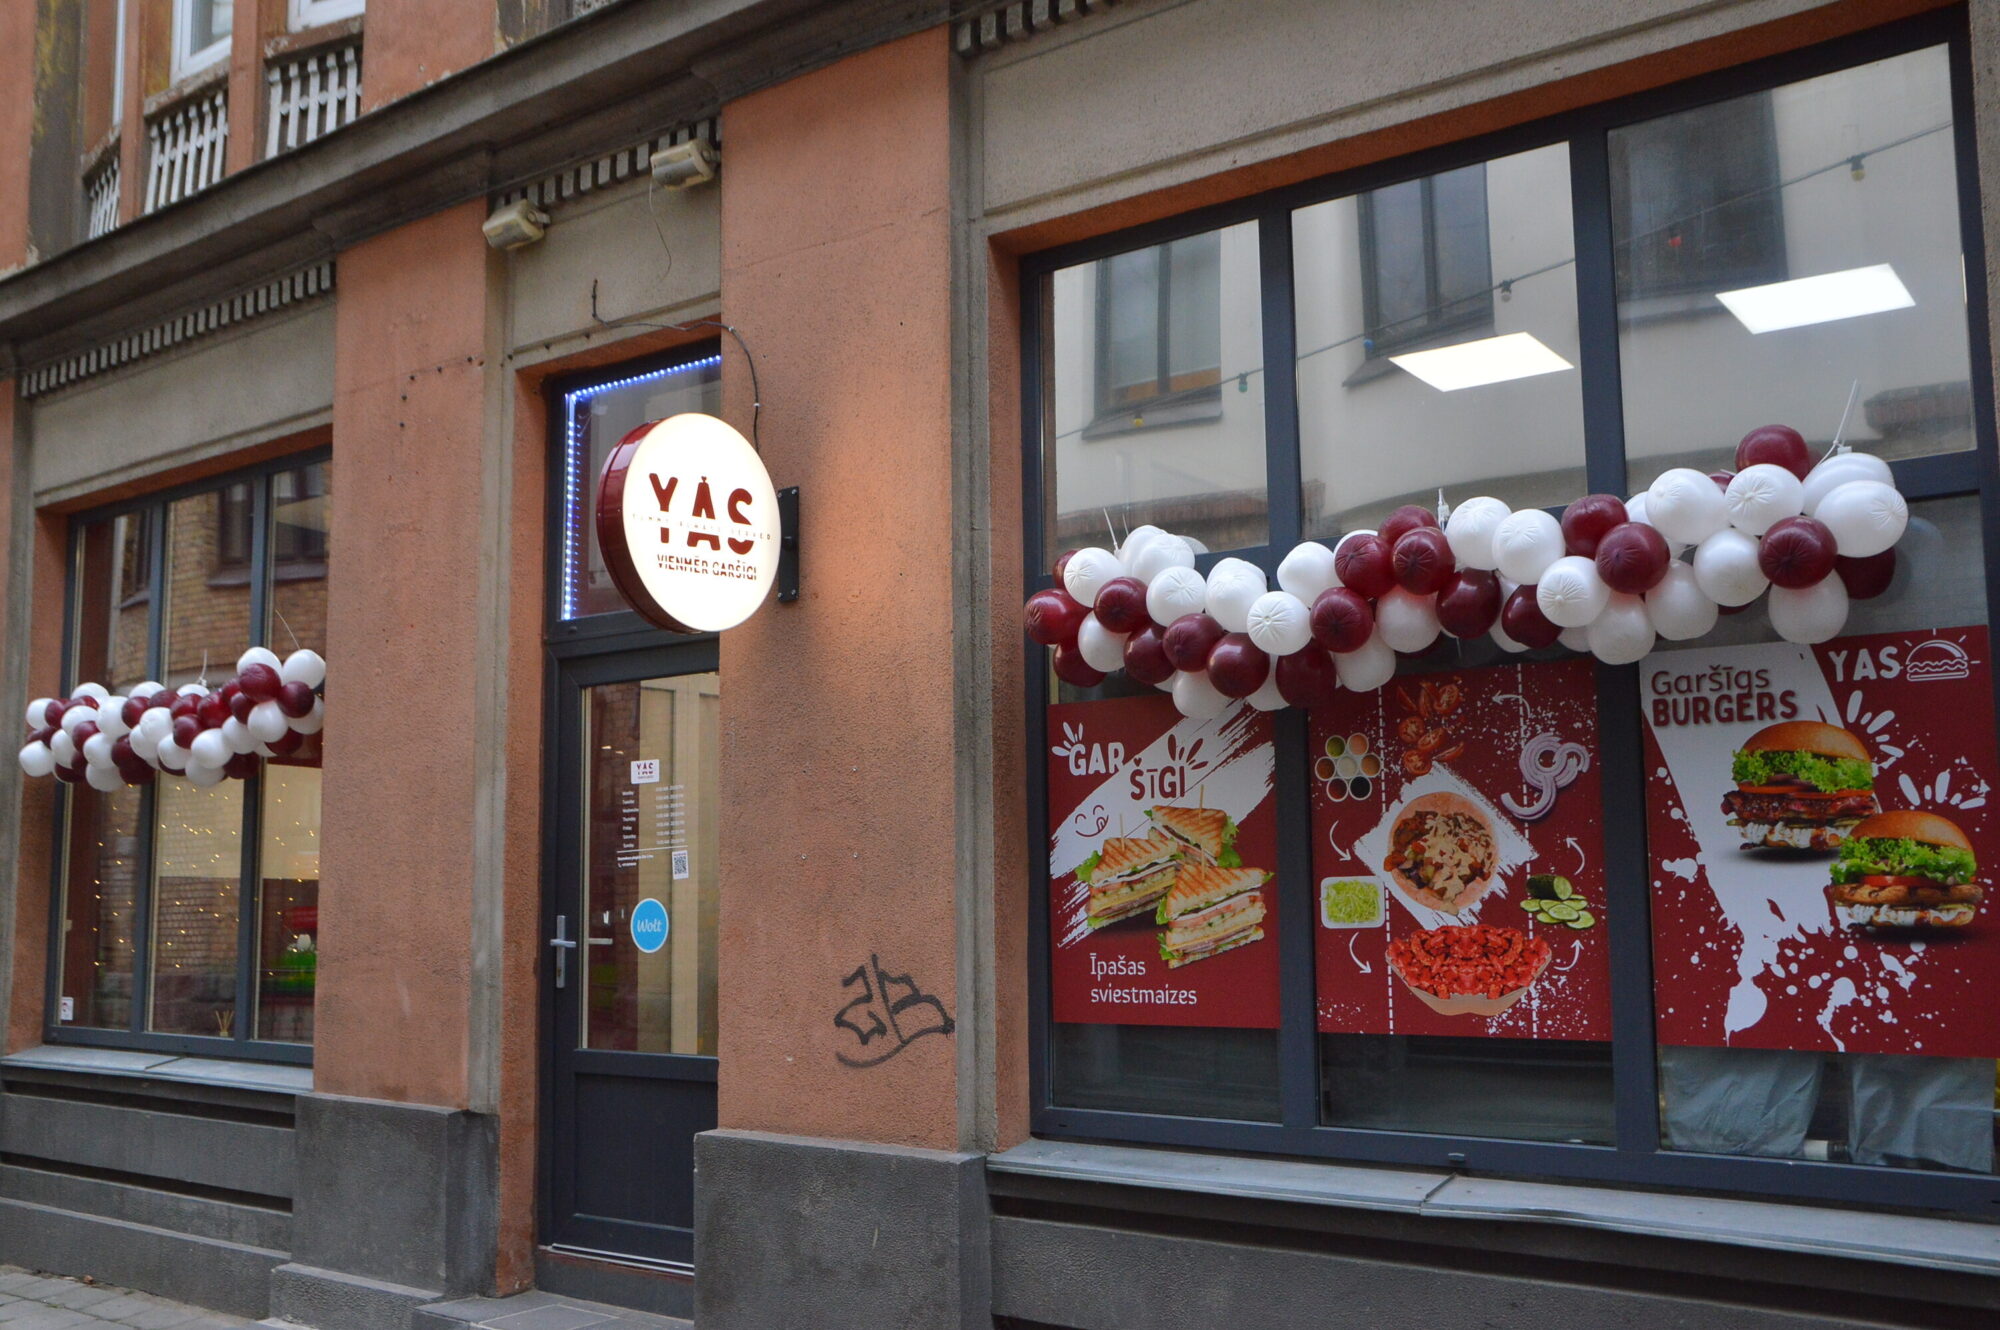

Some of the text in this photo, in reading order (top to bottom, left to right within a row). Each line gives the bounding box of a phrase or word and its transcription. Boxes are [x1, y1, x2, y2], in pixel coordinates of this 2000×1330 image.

[1651, 664, 1770, 695] Garšīgs
[1828, 646, 1901, 682] YAS
[1652, 690, 1798, 727] BURGERS
[1068, 741, 1125, 776] GAR
[1130, 758, 1186, 801] ŠĪGI
[637, 918, 663, 933] Wolt
[1089, 952, 1146, 981] Īpašas
[1090, 983, 1198, 1006] sviestmaizes
